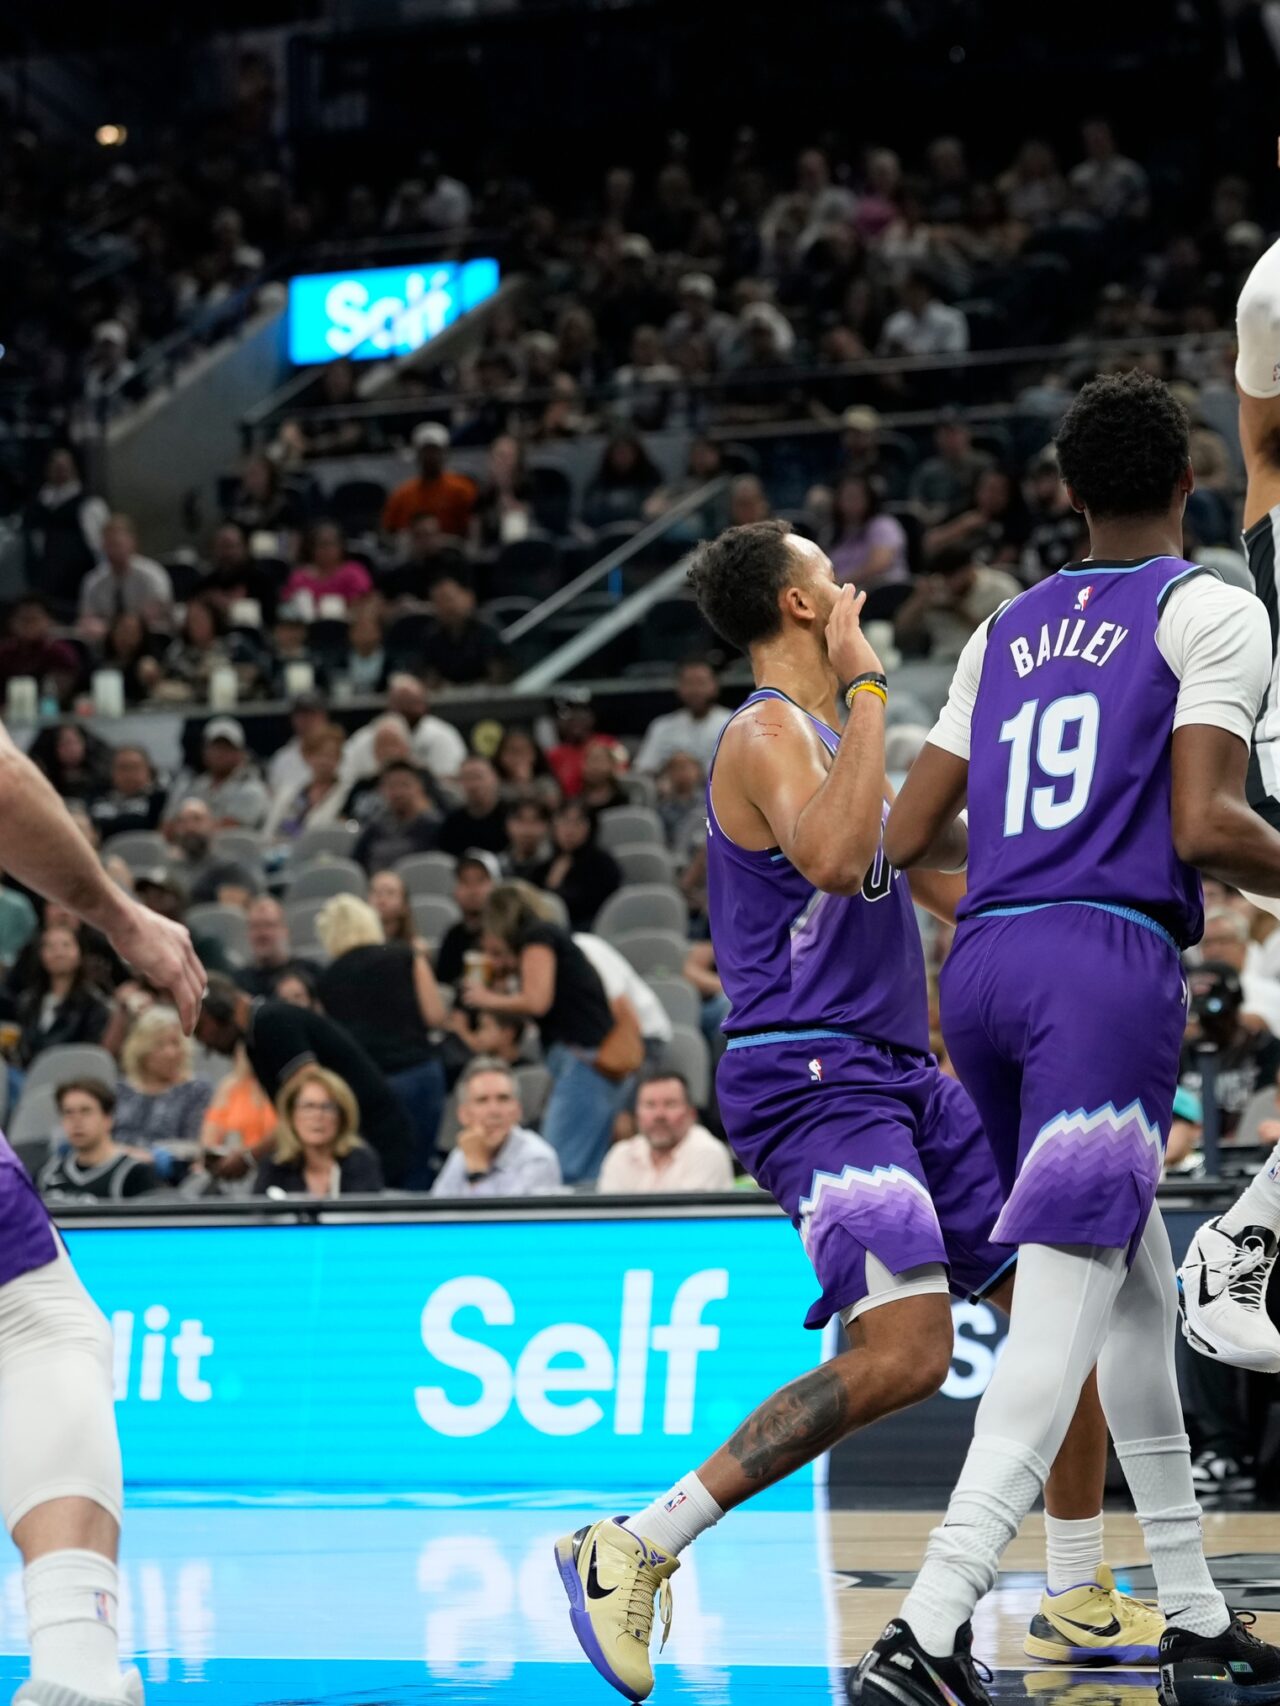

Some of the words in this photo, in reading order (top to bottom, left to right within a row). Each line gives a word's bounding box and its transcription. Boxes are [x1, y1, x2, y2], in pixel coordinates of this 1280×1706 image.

[1010, 618, 1129, 679] BAILEY
[999, 692, 1100, 838] 19
[414, 1269, 729, 1438] Self
